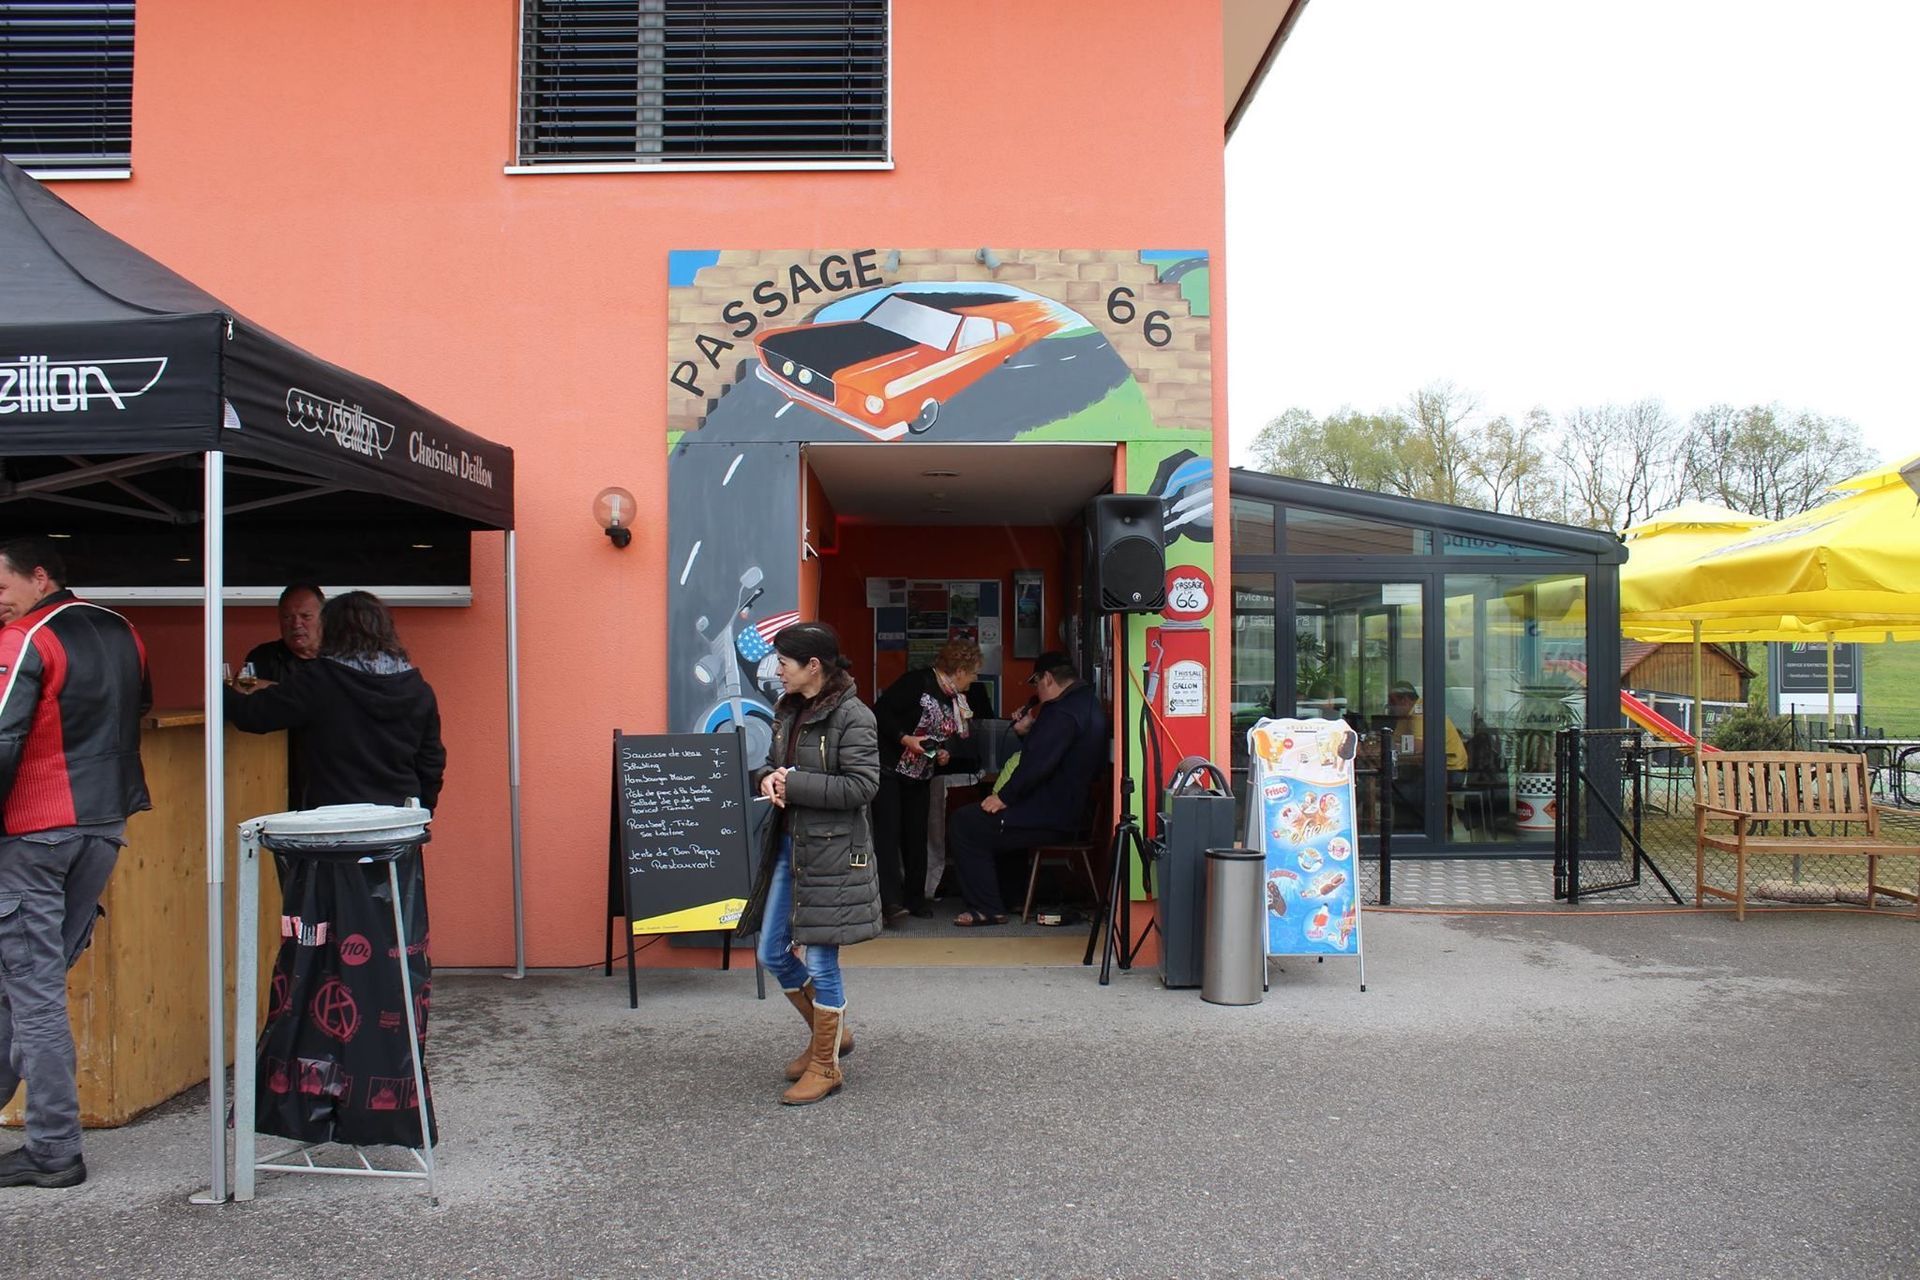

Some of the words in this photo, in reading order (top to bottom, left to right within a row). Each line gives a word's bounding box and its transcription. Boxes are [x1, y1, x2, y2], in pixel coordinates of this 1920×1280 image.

[670, 249, 883, 397] PASSAGE
[1107, 287, 1172, 347] 66
[1175, 580, 1203, 591] PASSAGE
[1176, 592, 1199, 608] 66
[1172, 682, 1198, 690] GALLON
[623, 747, 667, 760] Saucisse
[669, 747, 680, 757] de
[645, 789, 655, 797] de
[1264, 786, 1288, 797] Frisco
[660, 797, 672, 806] de
[655, 848, 669, 857] de
[668, 846, 691, 856] Bon
[689, 844, 721, 860] Repas
[651, 857, 717, 870] Restaurant
